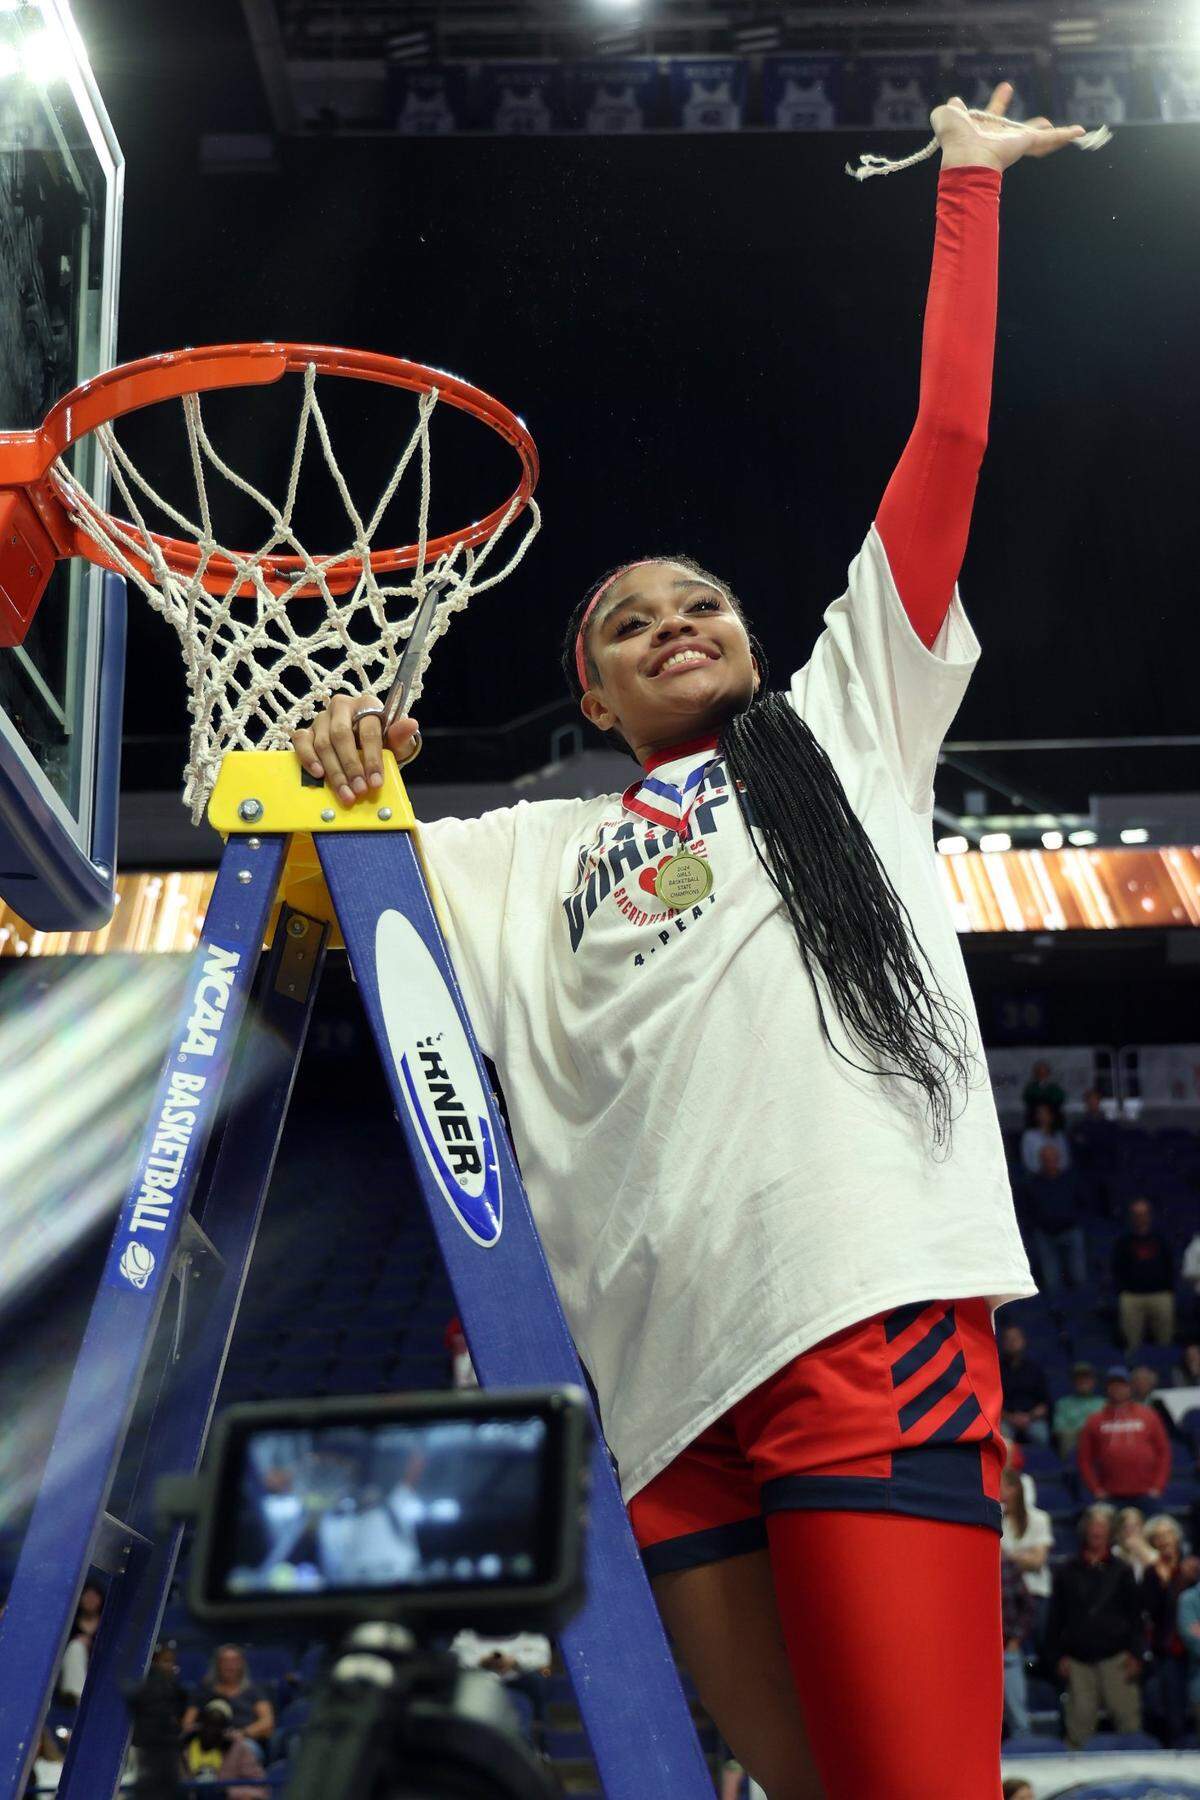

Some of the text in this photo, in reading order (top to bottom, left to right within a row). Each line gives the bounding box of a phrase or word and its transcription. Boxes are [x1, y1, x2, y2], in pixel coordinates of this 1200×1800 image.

[668, 876, 700, 886] BASKETBALL
[670, 888, 700, 898] CHAMPIONS
[614, 887, 648, 928] SACRED
[129, 943, 241, 1232] NCAA BASKETBALL
